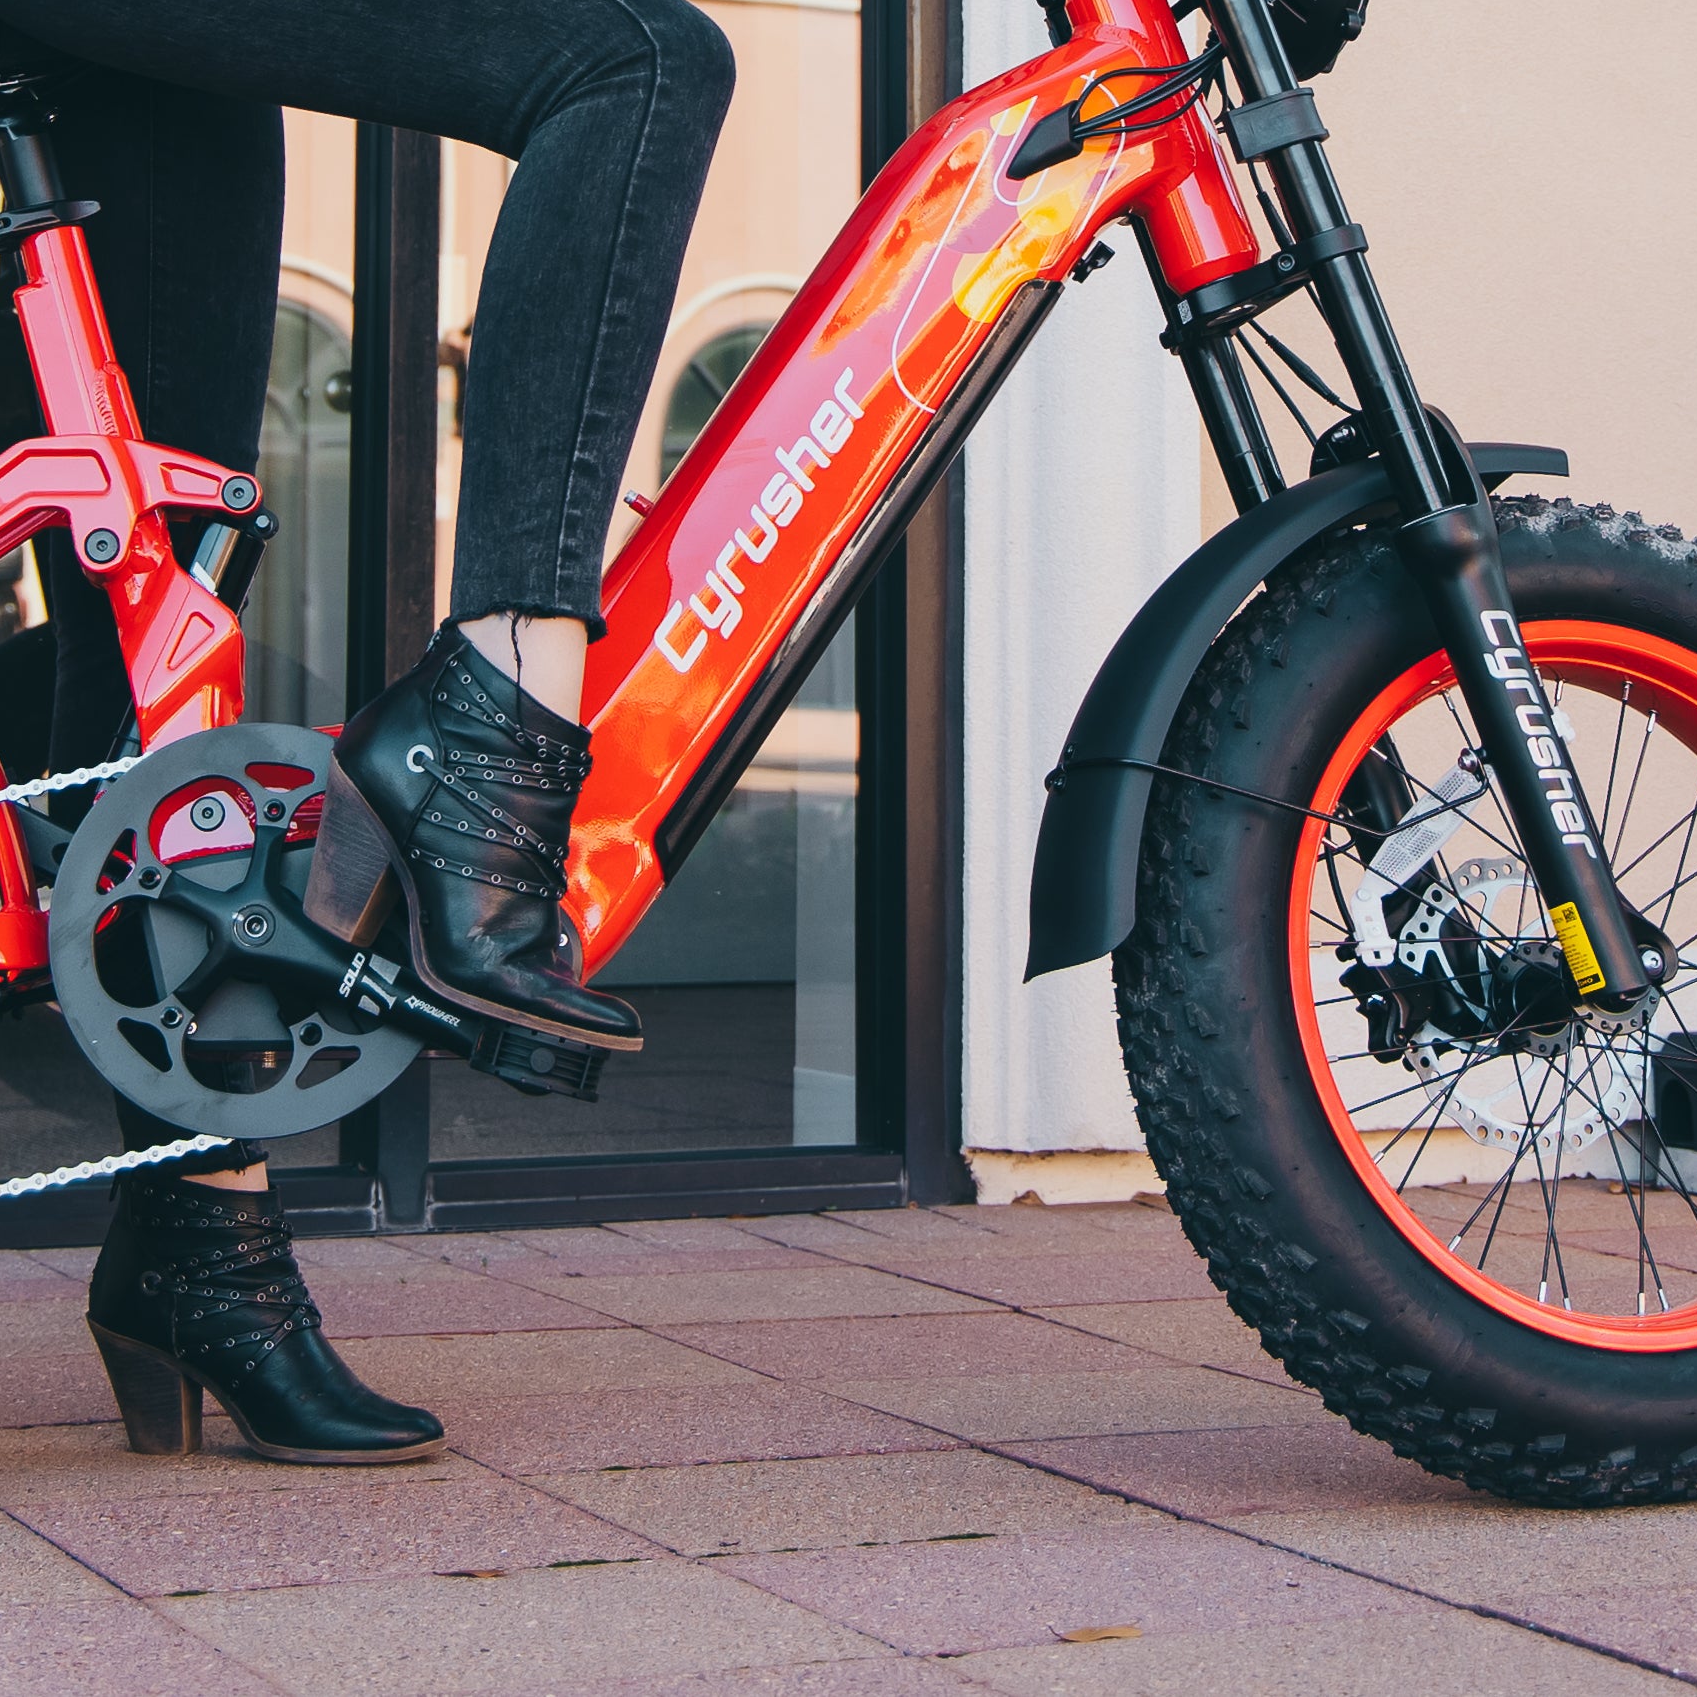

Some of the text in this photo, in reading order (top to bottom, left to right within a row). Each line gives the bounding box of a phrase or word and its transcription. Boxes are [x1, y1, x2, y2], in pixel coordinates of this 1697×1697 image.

[653, 366, 865, 674] Cyrusher
[1480, 609, 1598, 860] Cyrusher
[338, 952, 366, 998] SOLID
